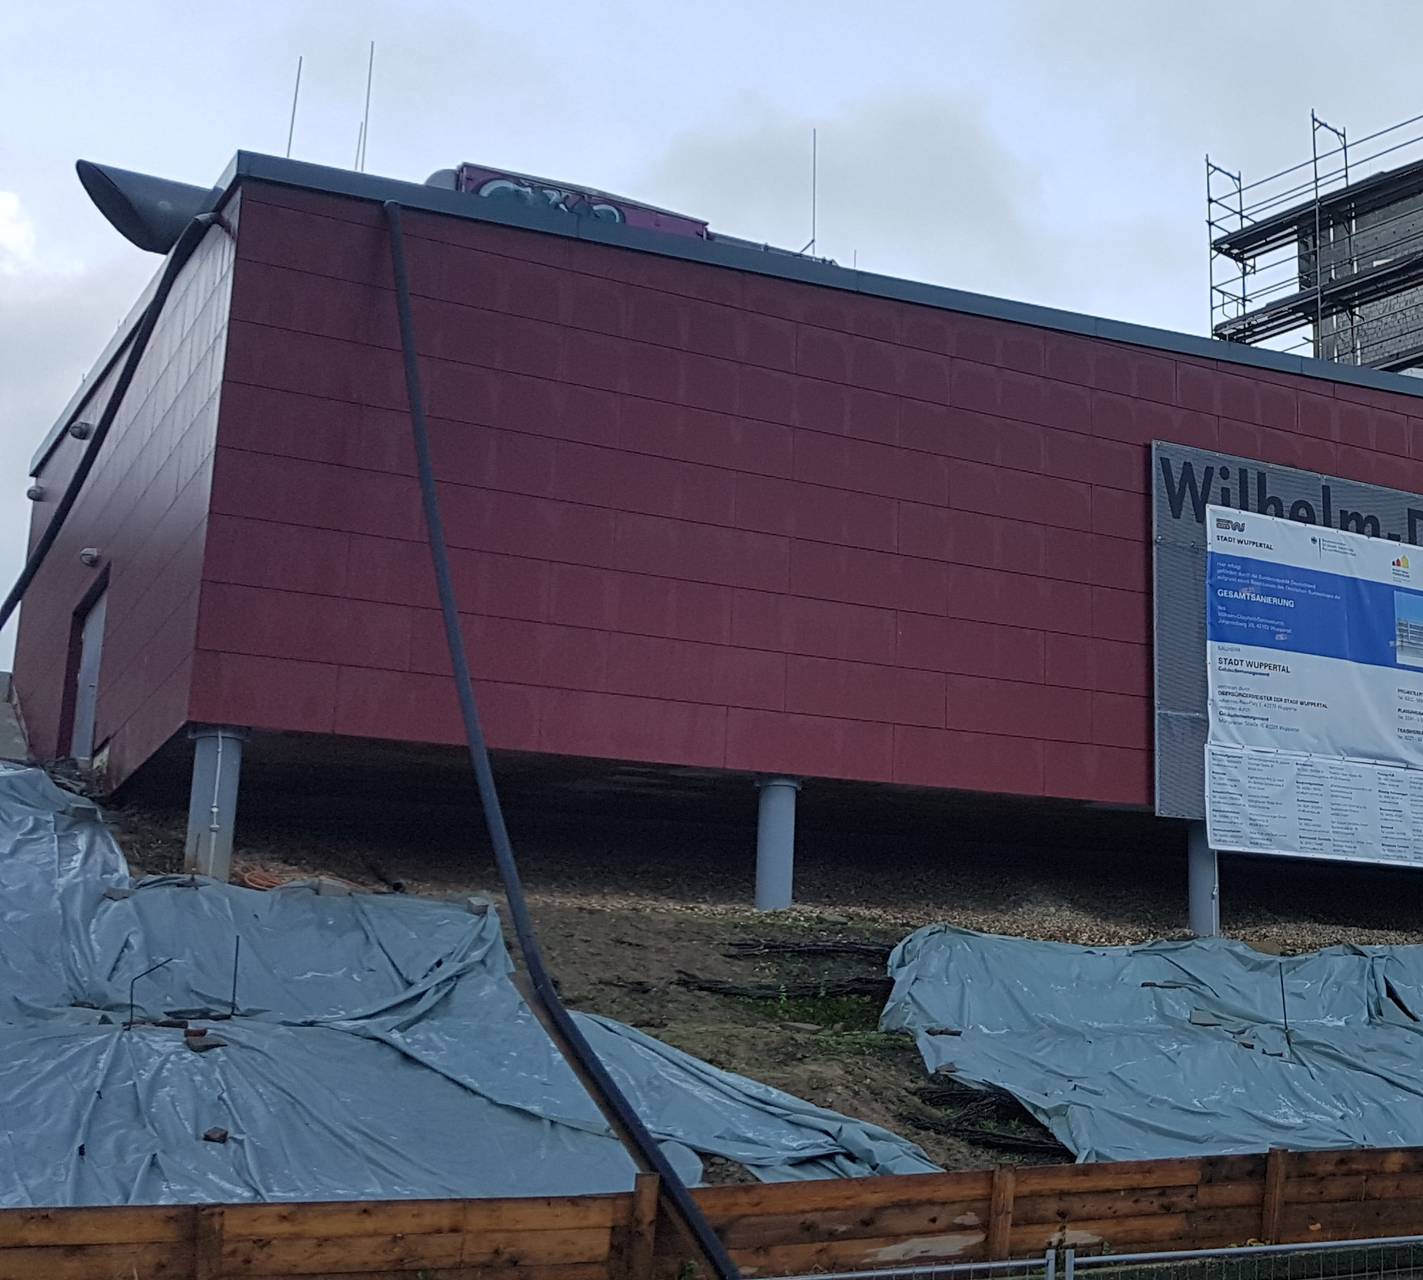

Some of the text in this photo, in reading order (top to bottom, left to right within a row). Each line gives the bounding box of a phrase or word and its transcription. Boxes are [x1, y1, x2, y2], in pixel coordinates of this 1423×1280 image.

[1237, 538, 1274, 550] WUPPERTAL
[1217, 588, 1295, 608] GESAMTSANIERUNG
[1218, 657, 1291, 673] STADT WUPPERTAL
